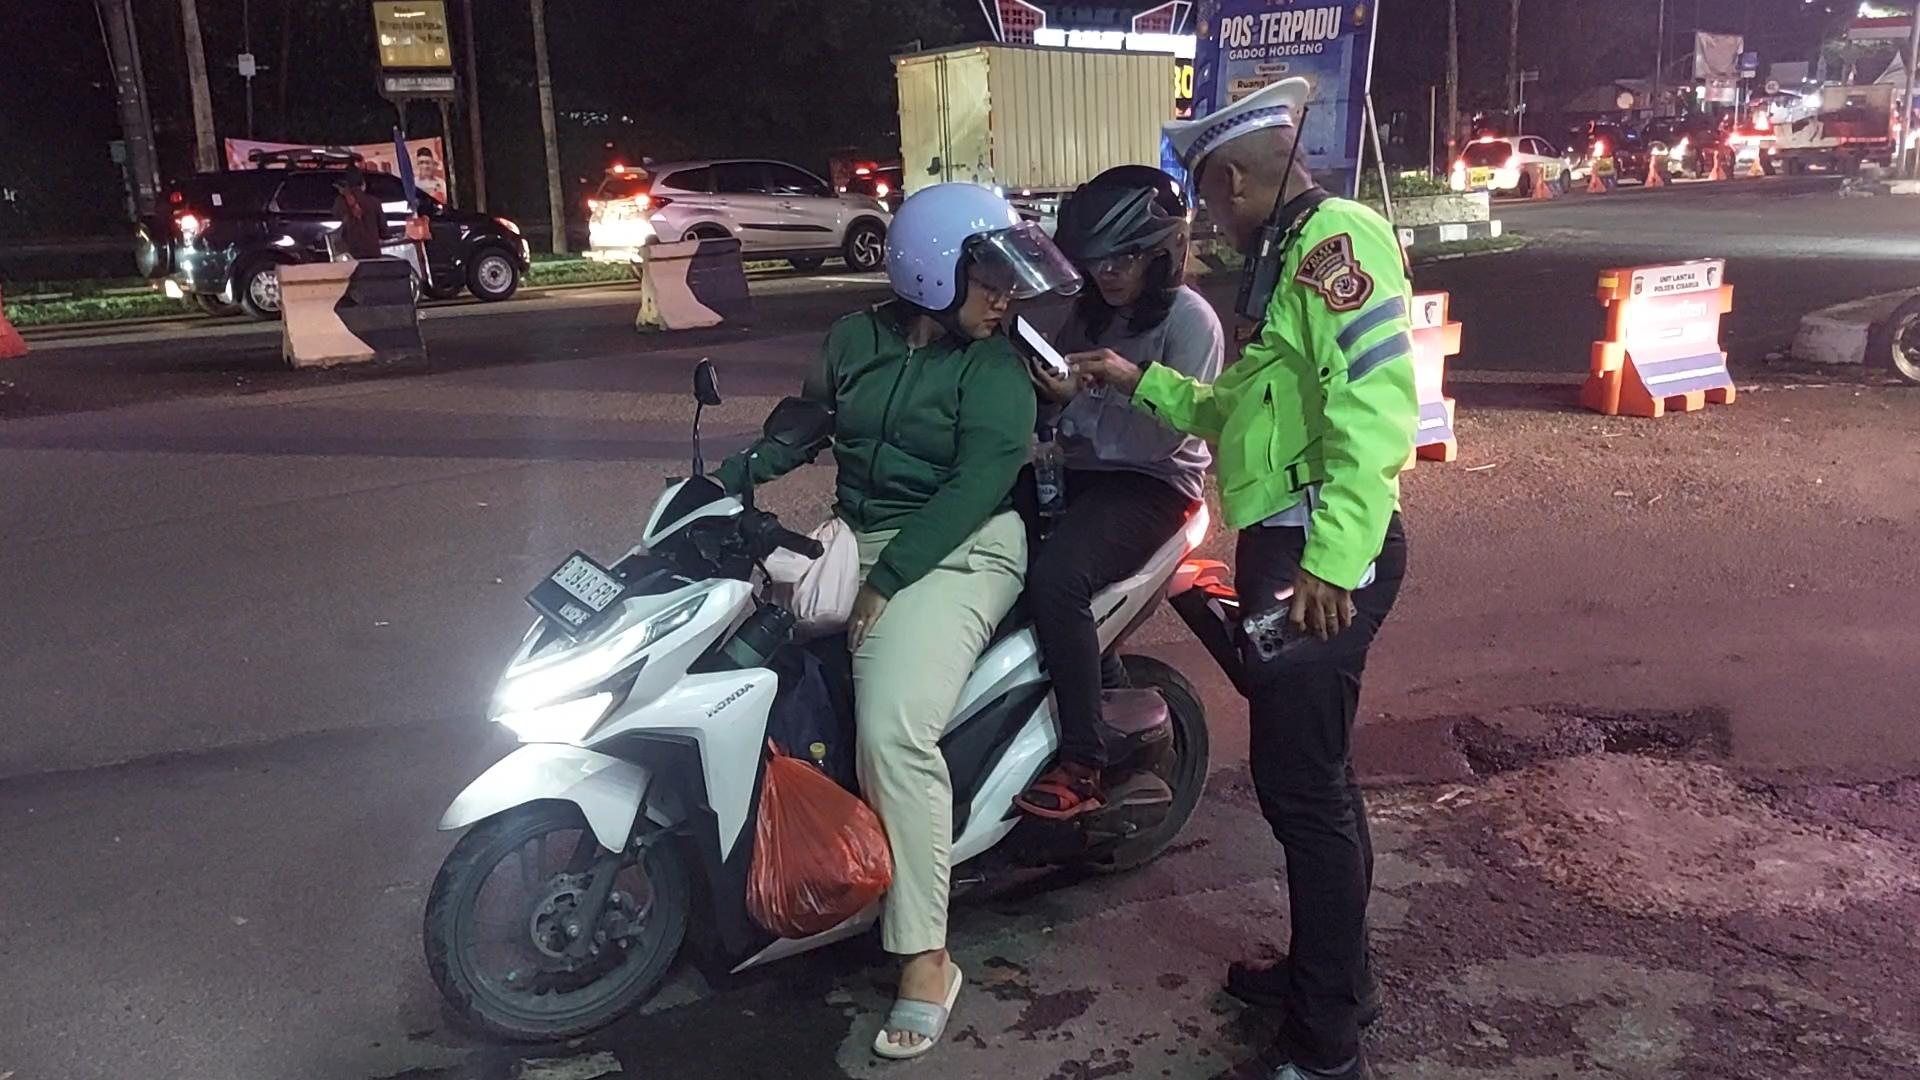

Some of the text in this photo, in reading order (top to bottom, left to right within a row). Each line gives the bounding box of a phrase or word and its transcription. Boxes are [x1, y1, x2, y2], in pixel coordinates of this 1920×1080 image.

[1219, 15, 1254, 48] POS
[1259, 6, 1342, 45] TERPADU
[1229, 43, 1323, 60] GADOG HOEGENG
[1237, 79, 1265, 90] Ruang
[1672, 273, 1695, 281] LANTAS
[1654, 284, 1674, 292] POLSEK
[705, 683, 755, 718] HONDA
